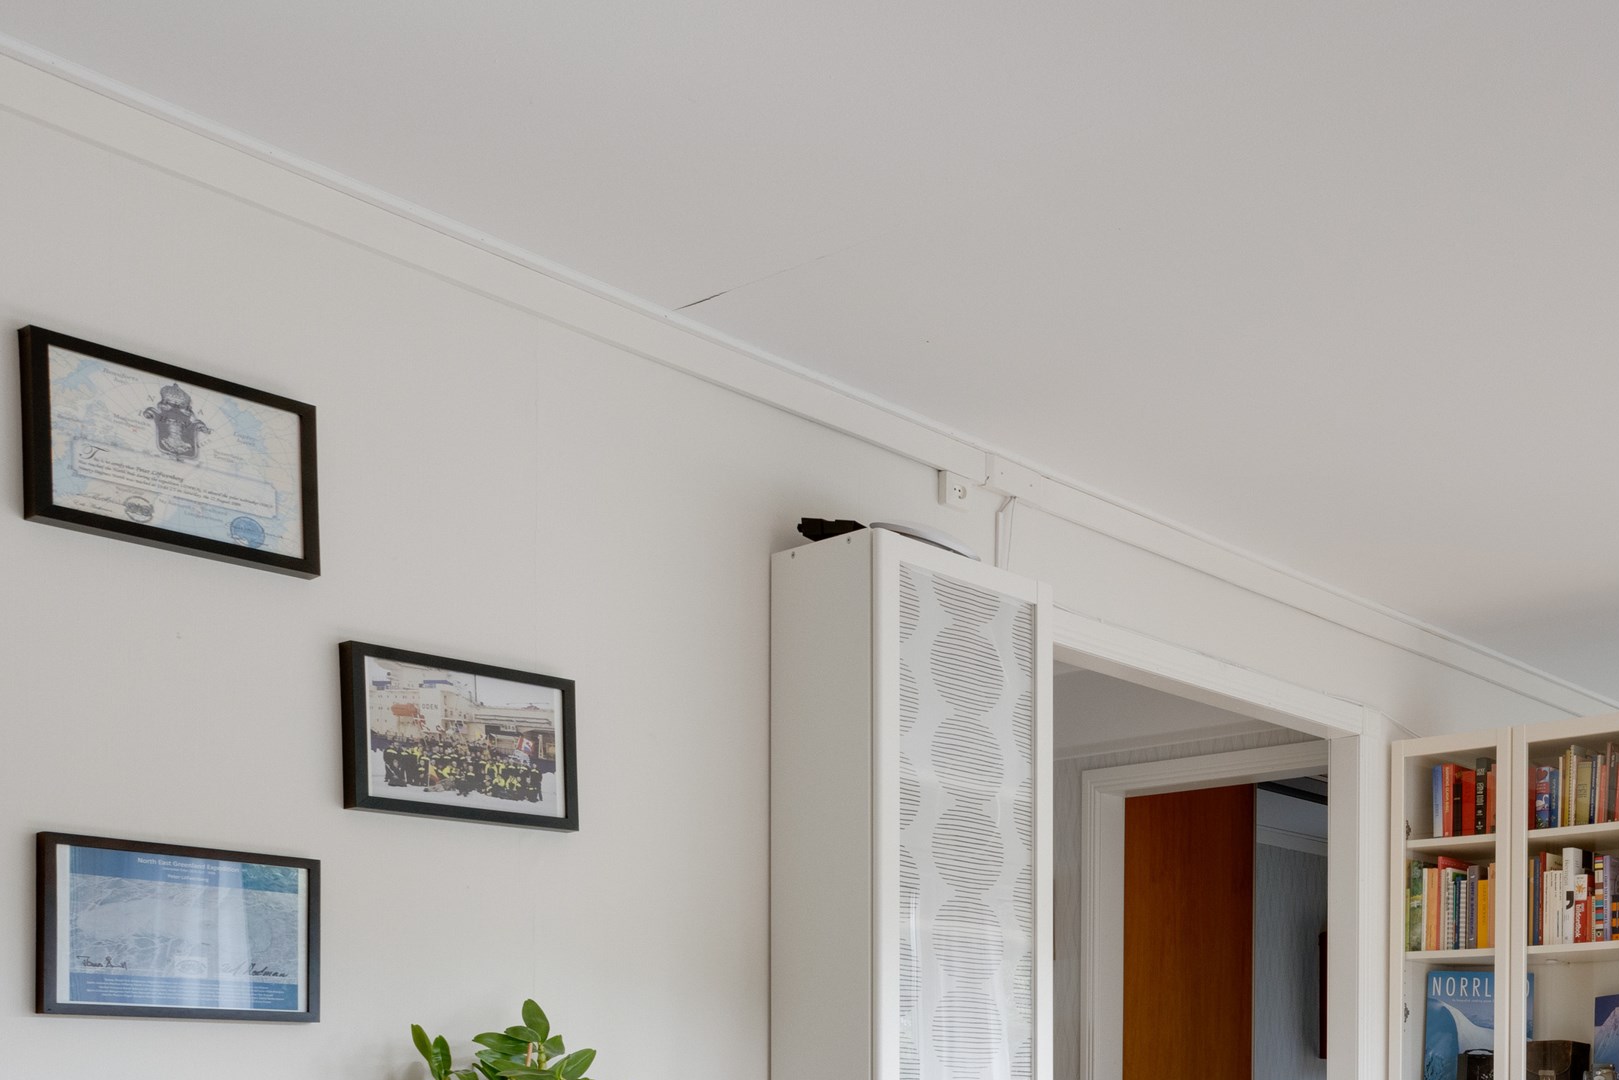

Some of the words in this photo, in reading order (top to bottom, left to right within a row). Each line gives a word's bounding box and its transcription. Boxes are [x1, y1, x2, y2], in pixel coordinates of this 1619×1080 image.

[137, 856, 156, 866] North
[157, 858, 172, 868] East
[172, 860, 206, 871] Greenland
[1432, 976, 1531, 998] NORRL
